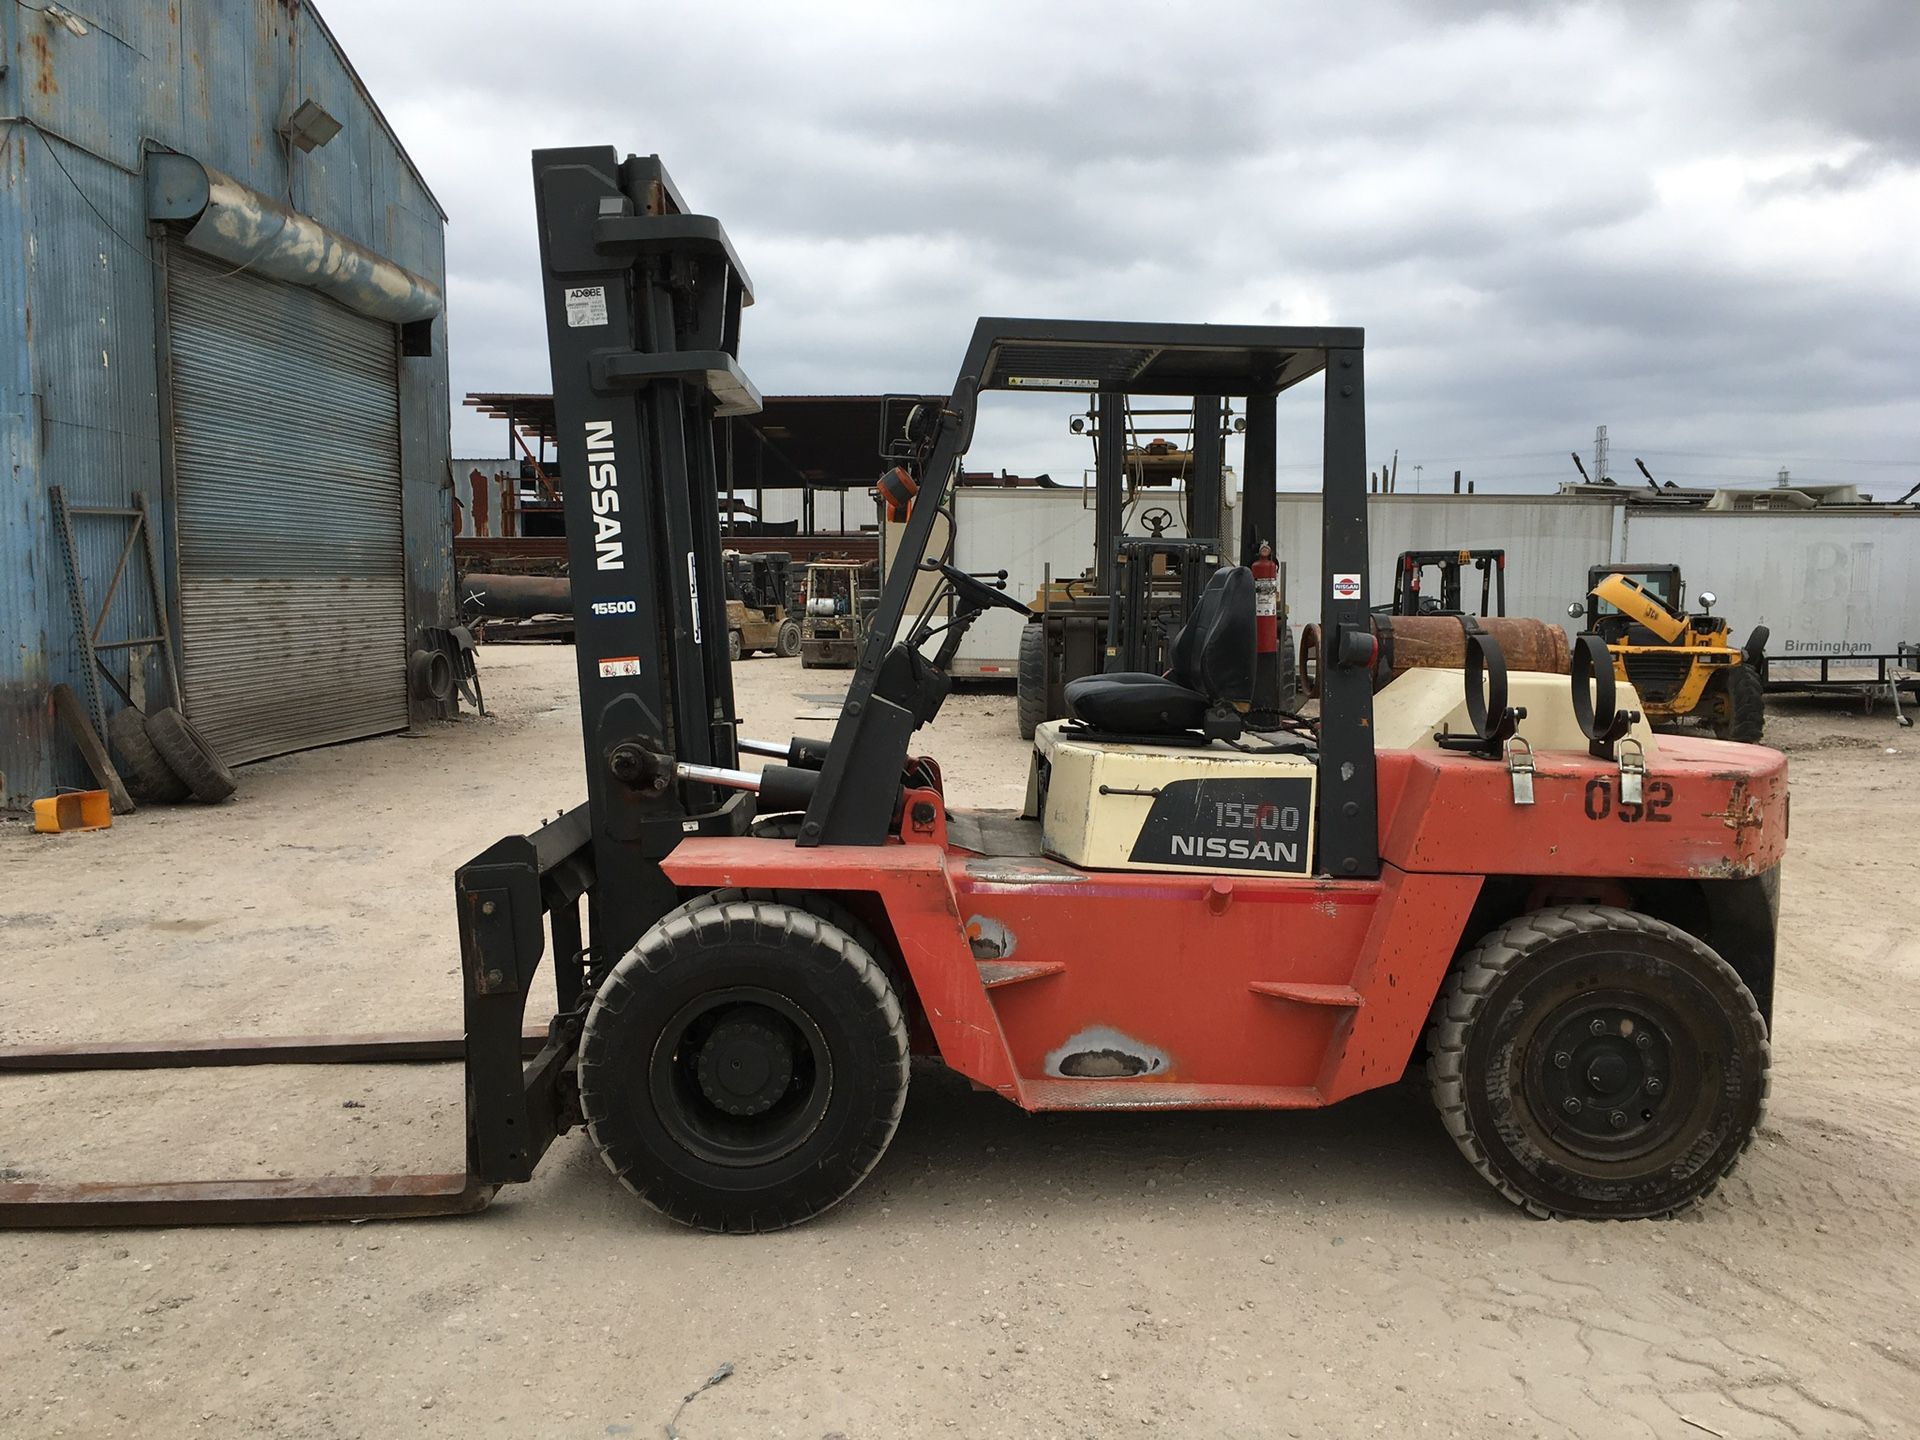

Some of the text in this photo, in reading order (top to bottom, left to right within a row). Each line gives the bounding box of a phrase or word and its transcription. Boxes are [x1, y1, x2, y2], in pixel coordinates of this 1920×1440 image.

[571, 288, 602, 298] ADOBE
[584, 420, 624, 571] NISSAN
[591, 600, 636, 614] 15500
[1785, 639, 1872, 654] Birmingham
[1216, 802, 1299, 832] 15500
[1171, 835, 1298, 863] NISSAN
